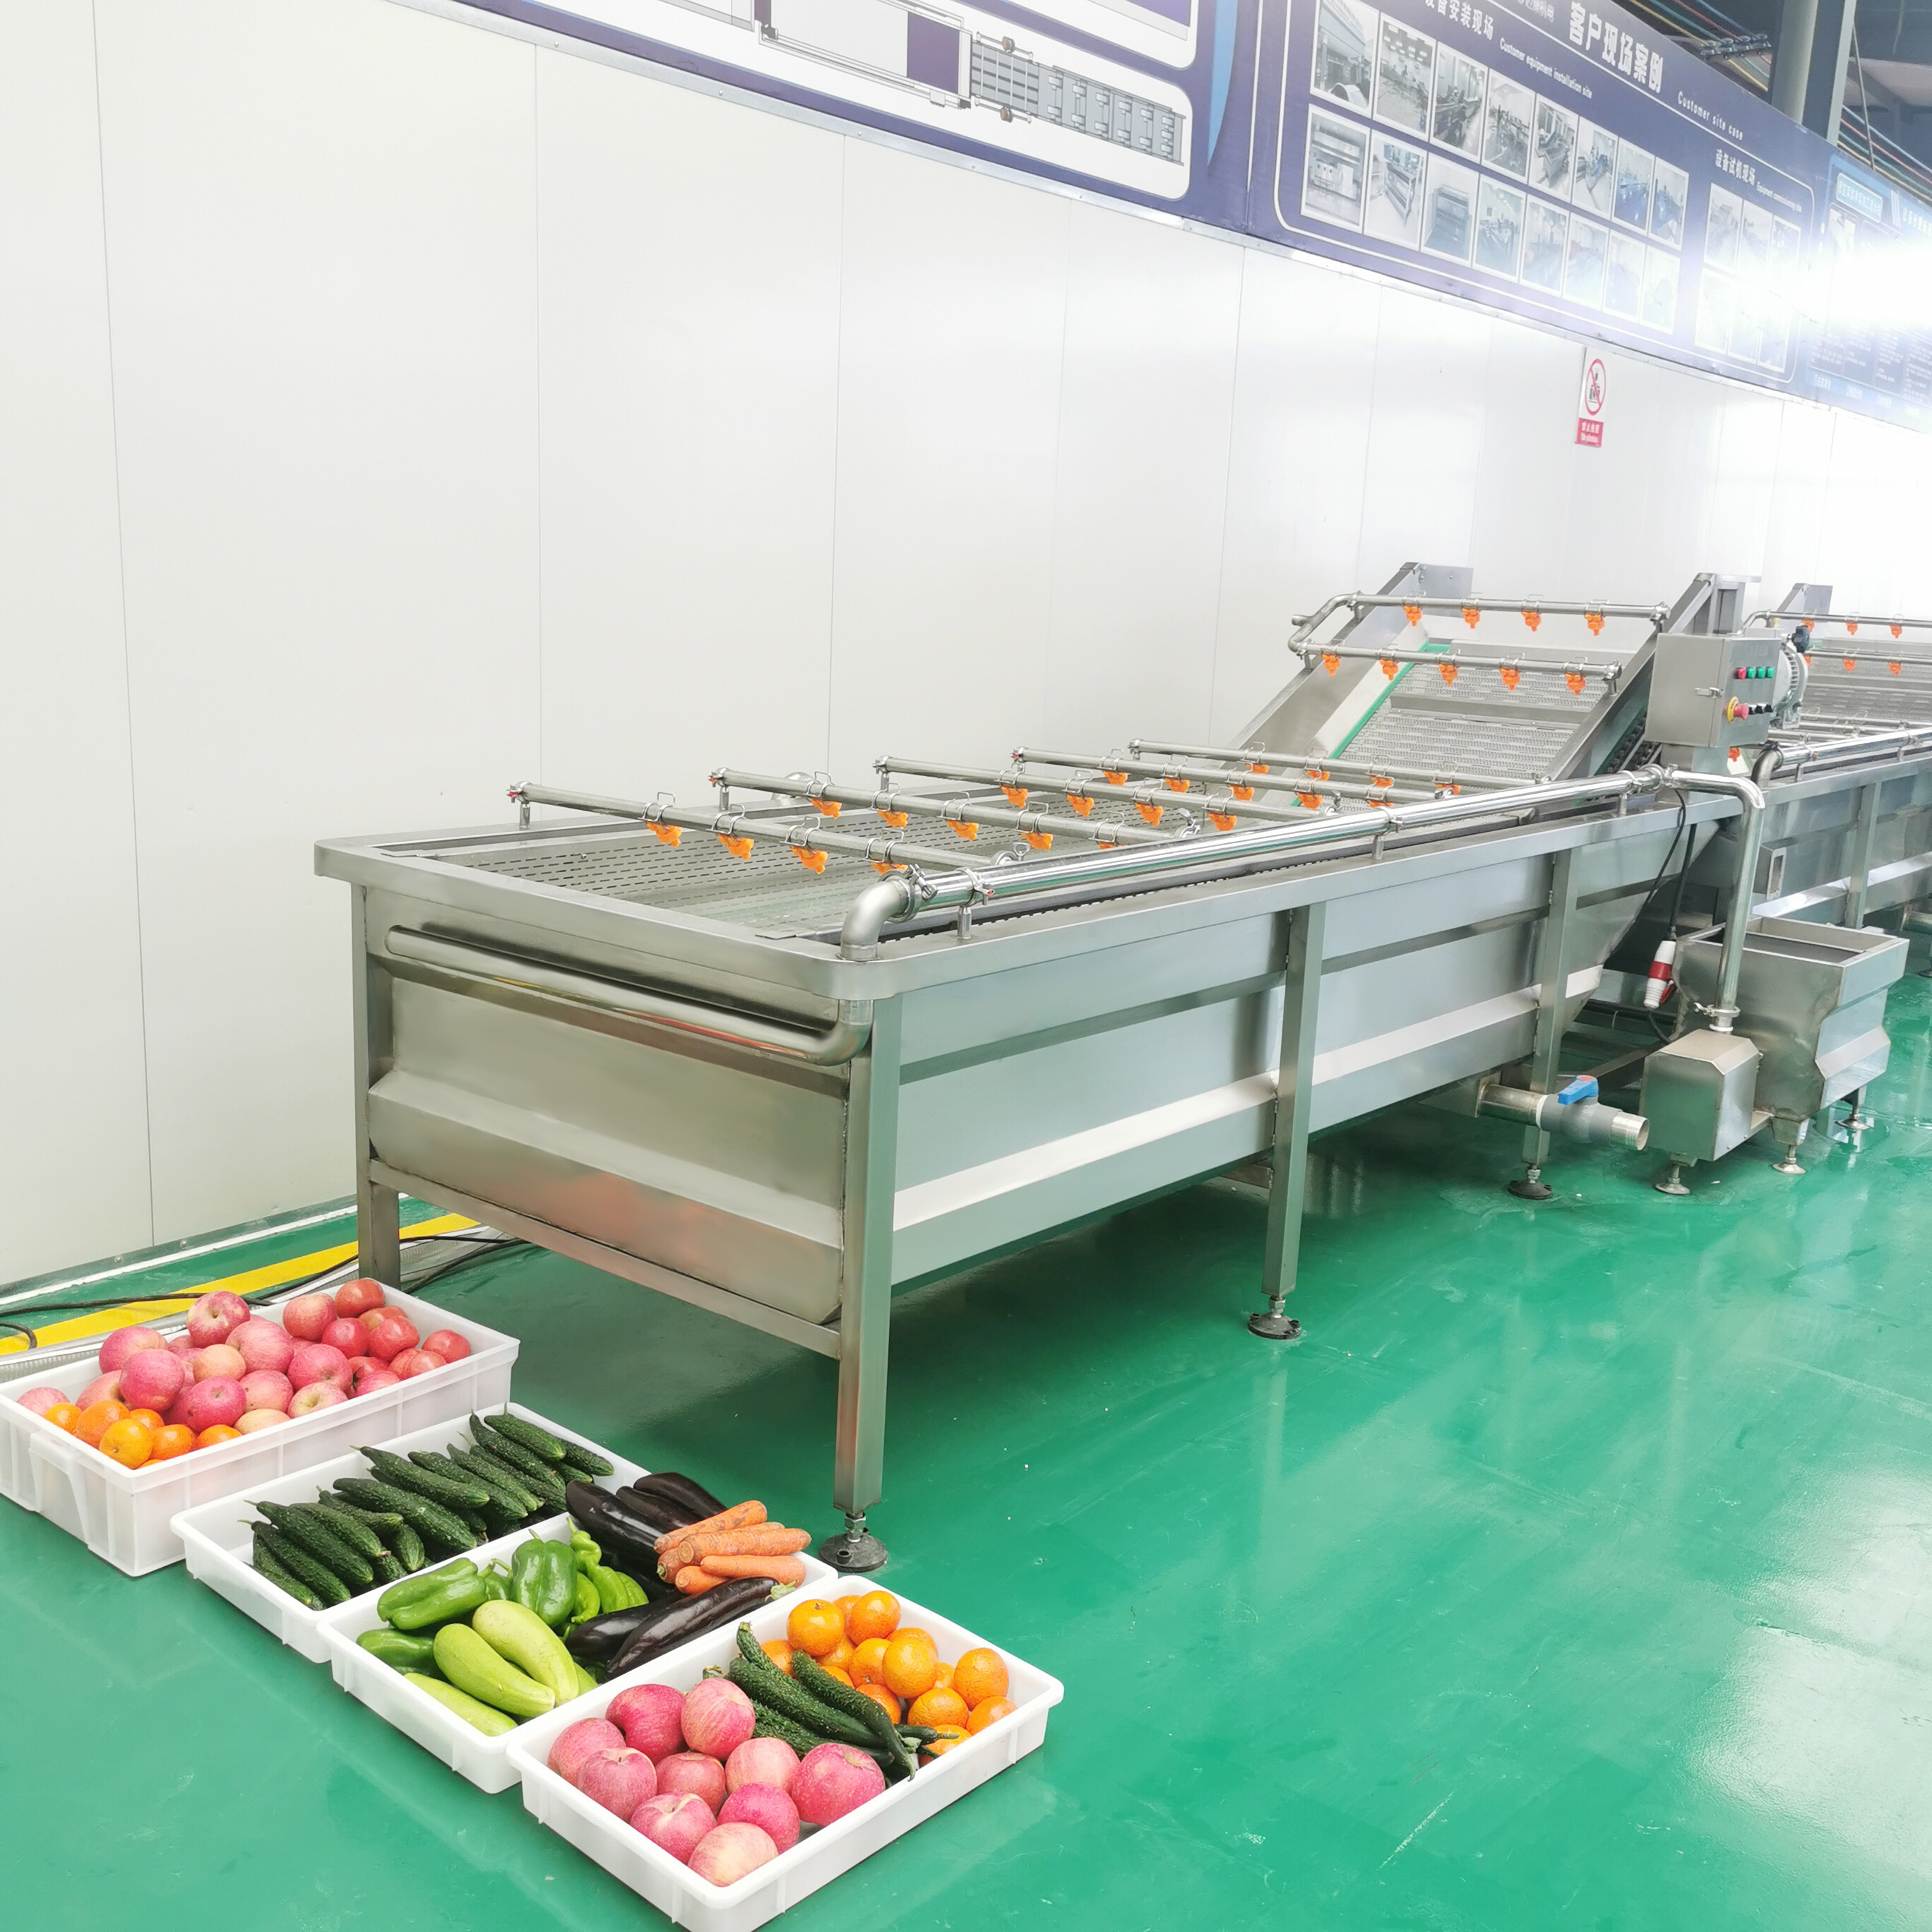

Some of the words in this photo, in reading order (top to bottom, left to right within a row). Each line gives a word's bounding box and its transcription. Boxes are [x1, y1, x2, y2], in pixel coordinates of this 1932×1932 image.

[1500, 37, 1525, 61] Customer
[1526, 55, 1553, 78] equipment
[1554, 68, 1582, 93] installation
[1582, 85, 1592, 99] site
[1569, 1, 1664, 93] 客户现场案例
[1678, 91, 1710, 121] Customer
[1712, 114, 1726, 131] site
[1728, 125, 1743, 141] case
